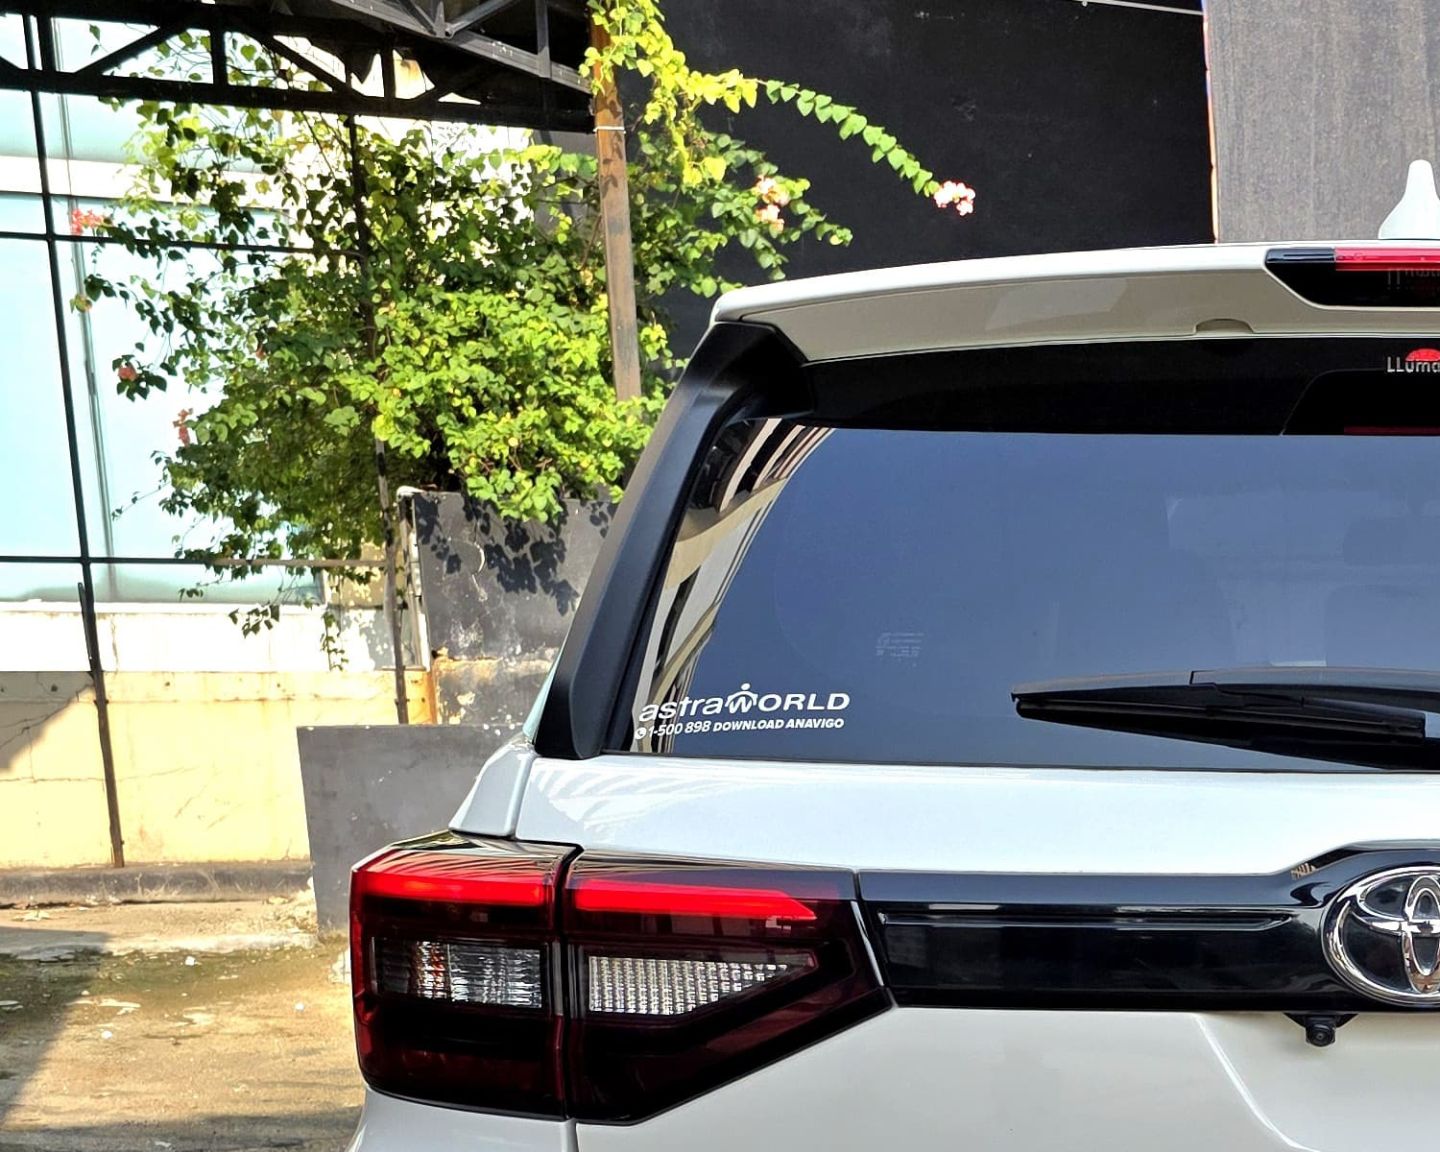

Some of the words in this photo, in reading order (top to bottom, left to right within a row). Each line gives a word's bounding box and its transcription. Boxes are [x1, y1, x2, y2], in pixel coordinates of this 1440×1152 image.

[647, 722, 683, 738] 1-500
[684, 720, 712, 734] 898
[713, 718, 784, 733] DOWNLOAD
[786, 717, 845, 730] ANAVIGO
